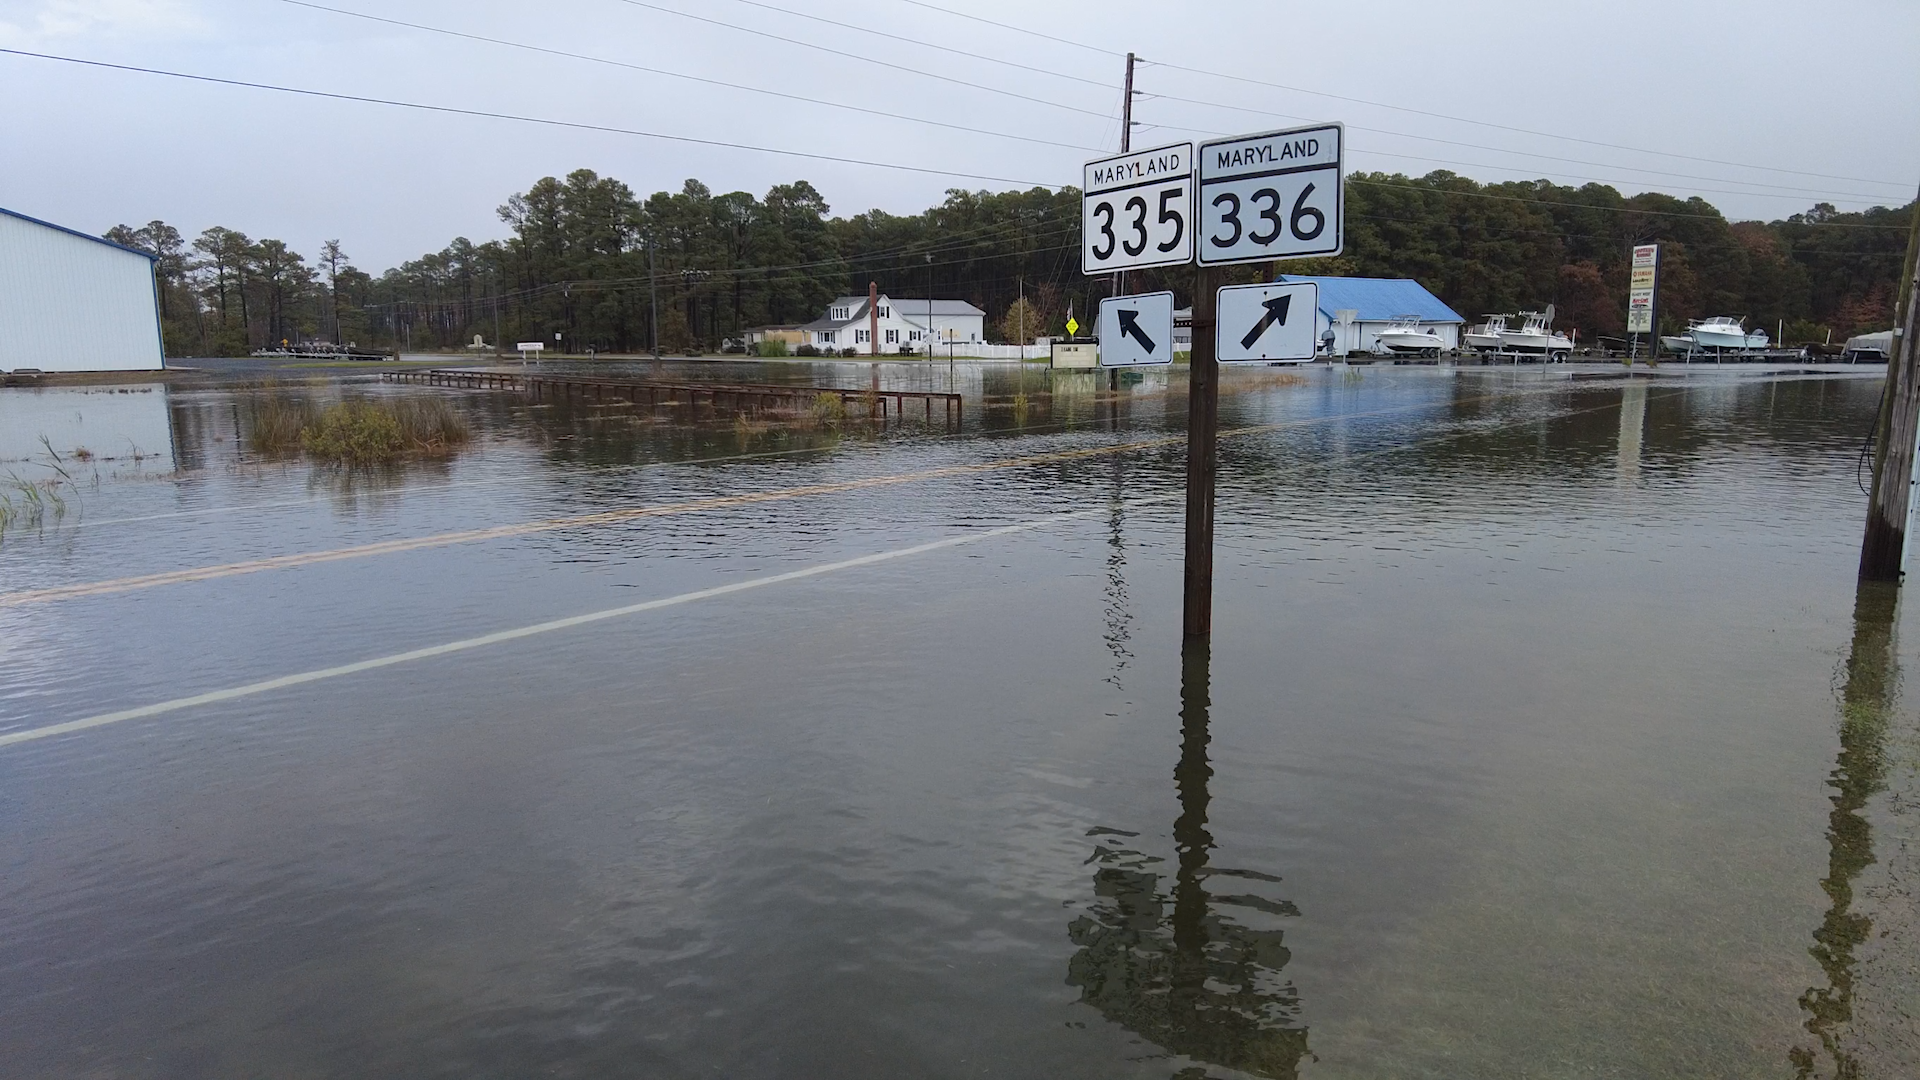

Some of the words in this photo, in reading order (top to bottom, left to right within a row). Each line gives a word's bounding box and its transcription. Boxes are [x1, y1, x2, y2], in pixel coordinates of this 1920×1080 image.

[1094, 154, 1180, 186] MARYLAND
[1218, 138, 1319, 169] MARYLAND
[1091, 187, 1184, 261] 335
[1210, 182, 1325, 248] 336
